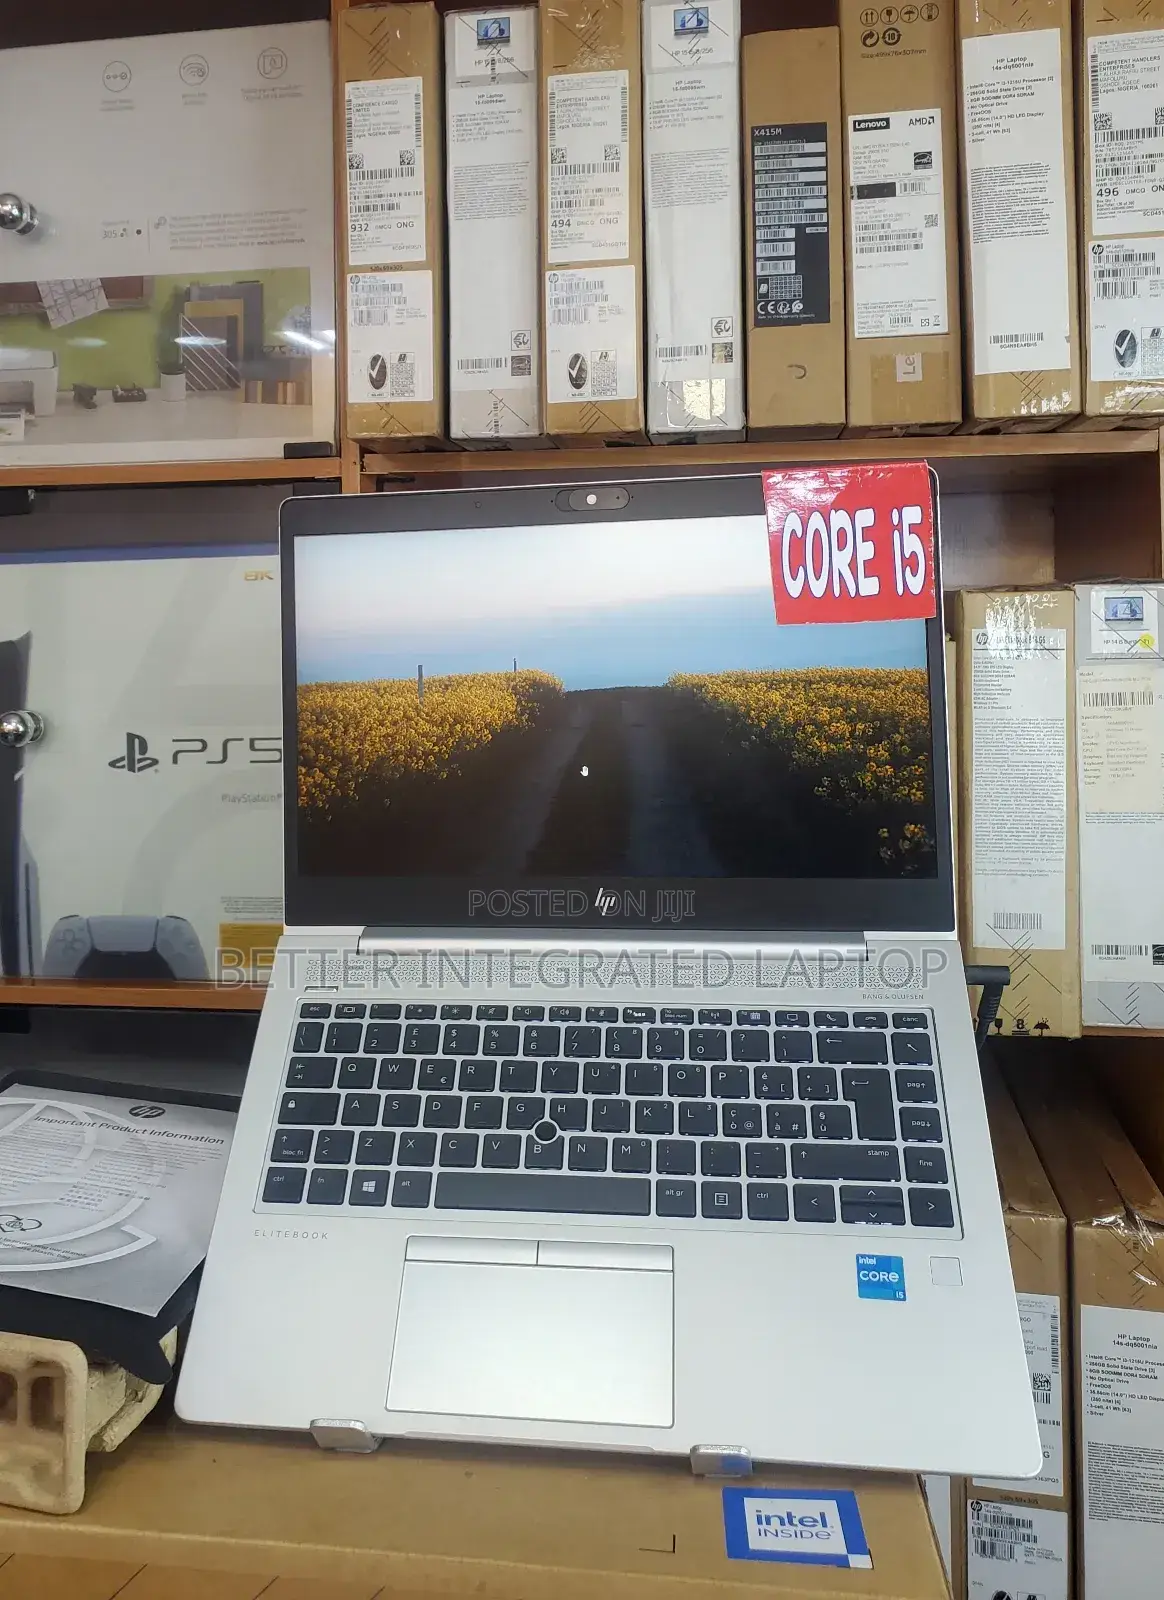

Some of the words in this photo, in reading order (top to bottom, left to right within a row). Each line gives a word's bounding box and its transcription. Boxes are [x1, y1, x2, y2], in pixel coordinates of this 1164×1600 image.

[855, 120, 887, 129] Lenovo
[908, 117, 927, 127] AMD
[753, 128, 782, 137] X415M
[1096, 187, 1120, 198] 496
[350, 223, 370, 232] 932
[396, 220, 415, 229] ONG
[551, 218, 571, 228] 494
[599, 217, 619, 225] ONG
[782, 507, 881, 599] CORE
[891, 505, 926, 596] i5
[244, 570, 274, 582] 8K
[172, 737, 282, 765] PS5
[594, 887, 616, 916] hp
[1016, 1019, 1025, 1030] 8
[427, 1065, 434, 1073] E
[468, 1066, 474, 1074] R
[677, 1071, 686, 1079] O
[719, 1072, 726, 1080] P
[352, 1100, 359, 1108] A
[392, 1101, 399, 1109] S
[433, 1102, 440, 1110] D
[644, 1108, 651, 1116] K
[688, 1109, 694, 1117] L
[34, 1115, 96, 1128] Important
[99, 1122, 148, 1136] Product
[150, 1129, 225, 1146] Information
[365, 1138, 373, 1146] Z
[407, 1139, 414, 1147] X
[449, 1140, 457, 1148] C
[534, 1143, 543, 1153] B
[578, 1144, 585, 1152] N
[622, 1146, 630, 1154] M
[254, 1229, 329, 1240] ELITEBOOK
[859, 1256, 877, 1265] intel
[896, 1291, 904, 1299] i5
[1128, 1334, 1151, 1343] Laptop
[756, 1509, 828, 1529] intel
